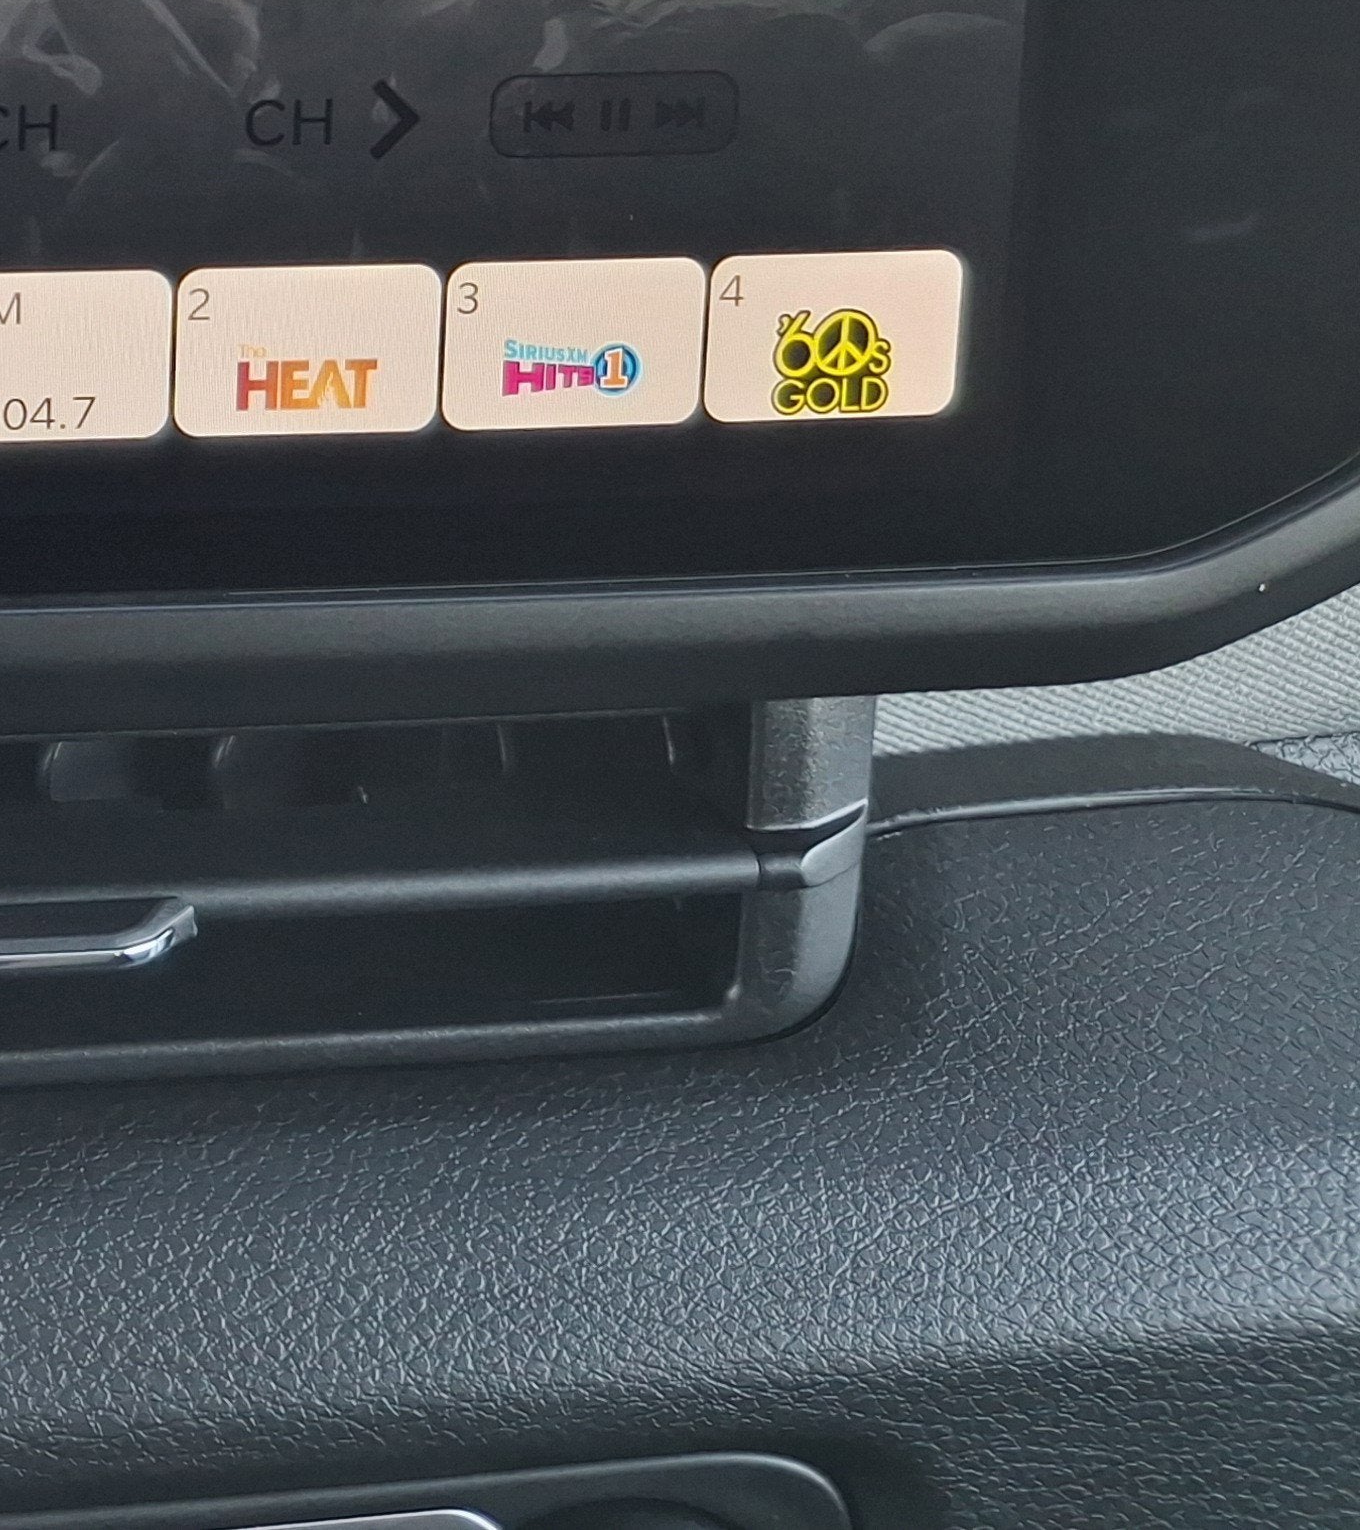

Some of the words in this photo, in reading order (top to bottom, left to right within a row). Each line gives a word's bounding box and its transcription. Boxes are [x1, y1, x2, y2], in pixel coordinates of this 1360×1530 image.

[244, 98, 334, 148] CH
[187, 288, 211, 320] 2
[456, 282, 479, 315] 3
[719, 275, 745, 307] 4
[236, 359, 378, 411] HEAT
[502, 360, 595, 397] HITS
[599, 347, 629, 389] 1
[771, 376, 889, 416] GOLD
